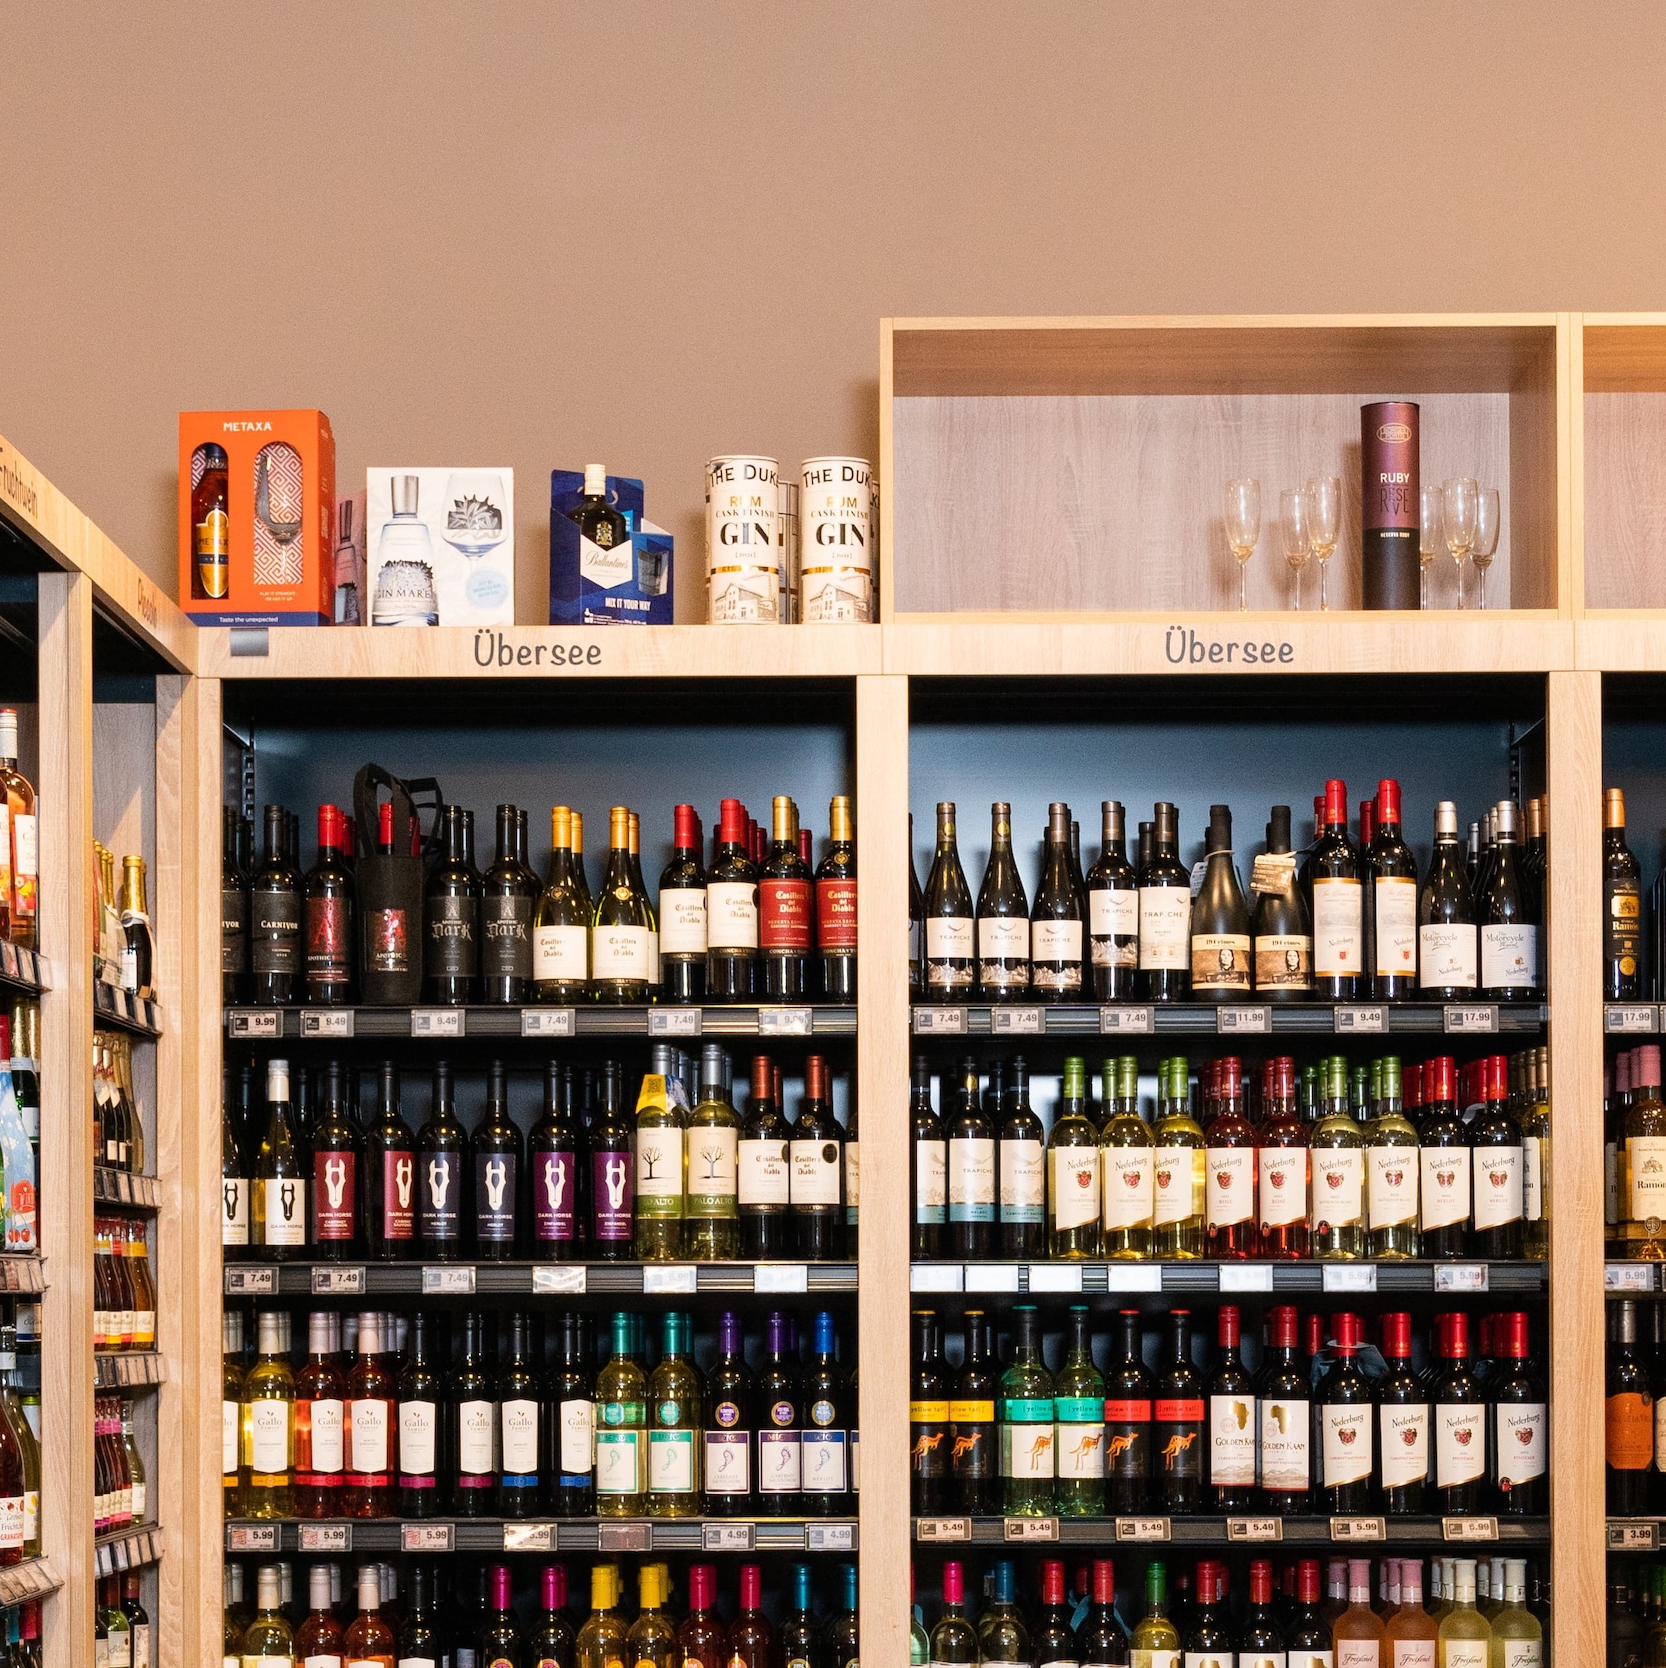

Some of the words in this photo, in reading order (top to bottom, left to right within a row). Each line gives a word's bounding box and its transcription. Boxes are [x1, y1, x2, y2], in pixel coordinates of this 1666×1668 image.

[223, 422, 273, 432] METAXA
[710, 468, 735, 488] THE
[743, 464, 779, 490] DUK
[803, 469, 833, 488] THE
[1380, 473, 1410, 484] RUBY
[715, 509, 739, 519] CASK
[811, 509, 835, 519] CASK
[720, 522, 771, 546] GIN
[816, 522, 865, 547] GIN
[585, 551, 629, 569] Ballantine's
[396, 589, 430, 599] MARE
[605, 597, 616, 608] MIX
[639, 600, 652, 611] WAY
[245, 617, 279, 625] unexpected
[473, 627, 603, 668] Übersee
[1165, 625, 1295, 664] Übersee
[779, 904, 802, 913] Diablo
[261, 920, 299, 930] CARNIVOR
[1205, 938, 1214, 946] 19
[1215, 938, 1236, 946] Crimes
[1422, 933, 1458, 943] Motorcycle
[1486, 933, 1524, 943] Motorcycle
[255, 1017, 275, 1026] 9.99
[326, 1017, 346, 1026] 9.49
[437, 1016, 457, 1026] 9.49
[547, 1015, 568, 1024] 7.49
[674, 1015, 694, 1024] 7.49
[939, 1013, 960, 1022] 7.49
[1017, 1013, 1037, 1022] 7.49
[1126, 1013, 1146, 1022] 7.49
[1237, 1013, 1263, 1022] 11.99
[1360, 1013, 1380, 1022] 9.49
[1464, 1013, 1490, 1022] 17.99
[1623, 1012, 1651, 1022] 17.99
[1067, 1157, 1098, 1170] Nederburg
[1115, 1157, 1150, 1170] Nederburg
[1210, 1157, 1242, 1170] Nederburg
[1263, 1157, 1296, 1170] Nederburg
[1318, 1158, 1352, 1171] Nederburg
[1377, 1157, 1410, 1170] Nederburg
[1429, 1157, 1462, 1170] Nederburg
[1482, 1157, 1515, 1170] Nederburg
[251, 1273, 271, 1282] 7.49
[338, 1273, 358, 1282] 7.49
[448, 1272, 468, 1282] 7.49
[258, 1417, 282, 1426] Gallo
[318, 1417, 341, 1425] Gallo
[356, 1417, 382, 1425] Gallo
[404, 1418, 429, 1427] Gallo
[467, 1417, 490, 1426] Gallo
[508, 1417, 533, 1426] Gallo
[1330, 1414, 1364, 1428] Nederburg
[1391, 1414, 1424, 1428] Nederburg
[1446, 1414, 1479, 1428] Nederburg
[1500, 1414, 1541, 1428] Nederburg
[1261, 1442, 1285, 1450] GOLDEN
[1286, 1442, 1305, 1450] KAAN
[943, 1523, 963, 1532] 5.49
[1030, 1523, 1050, 1532] 5.49
[1141, 1523, 1162, 1532] 5.49
[1253, 1523, 1274, 1531] 5.49
[1356, 1523, 1377, 1531] 5.99
[252, 1530, 273, 1539] 5.99
[323, 1530, 344, 1539] 5.99
[426, 1530, 447, 1539] 5.99
[727, 1530, 748, 1539] 4.99
[830, 1530, 851, 1539] 4.99
